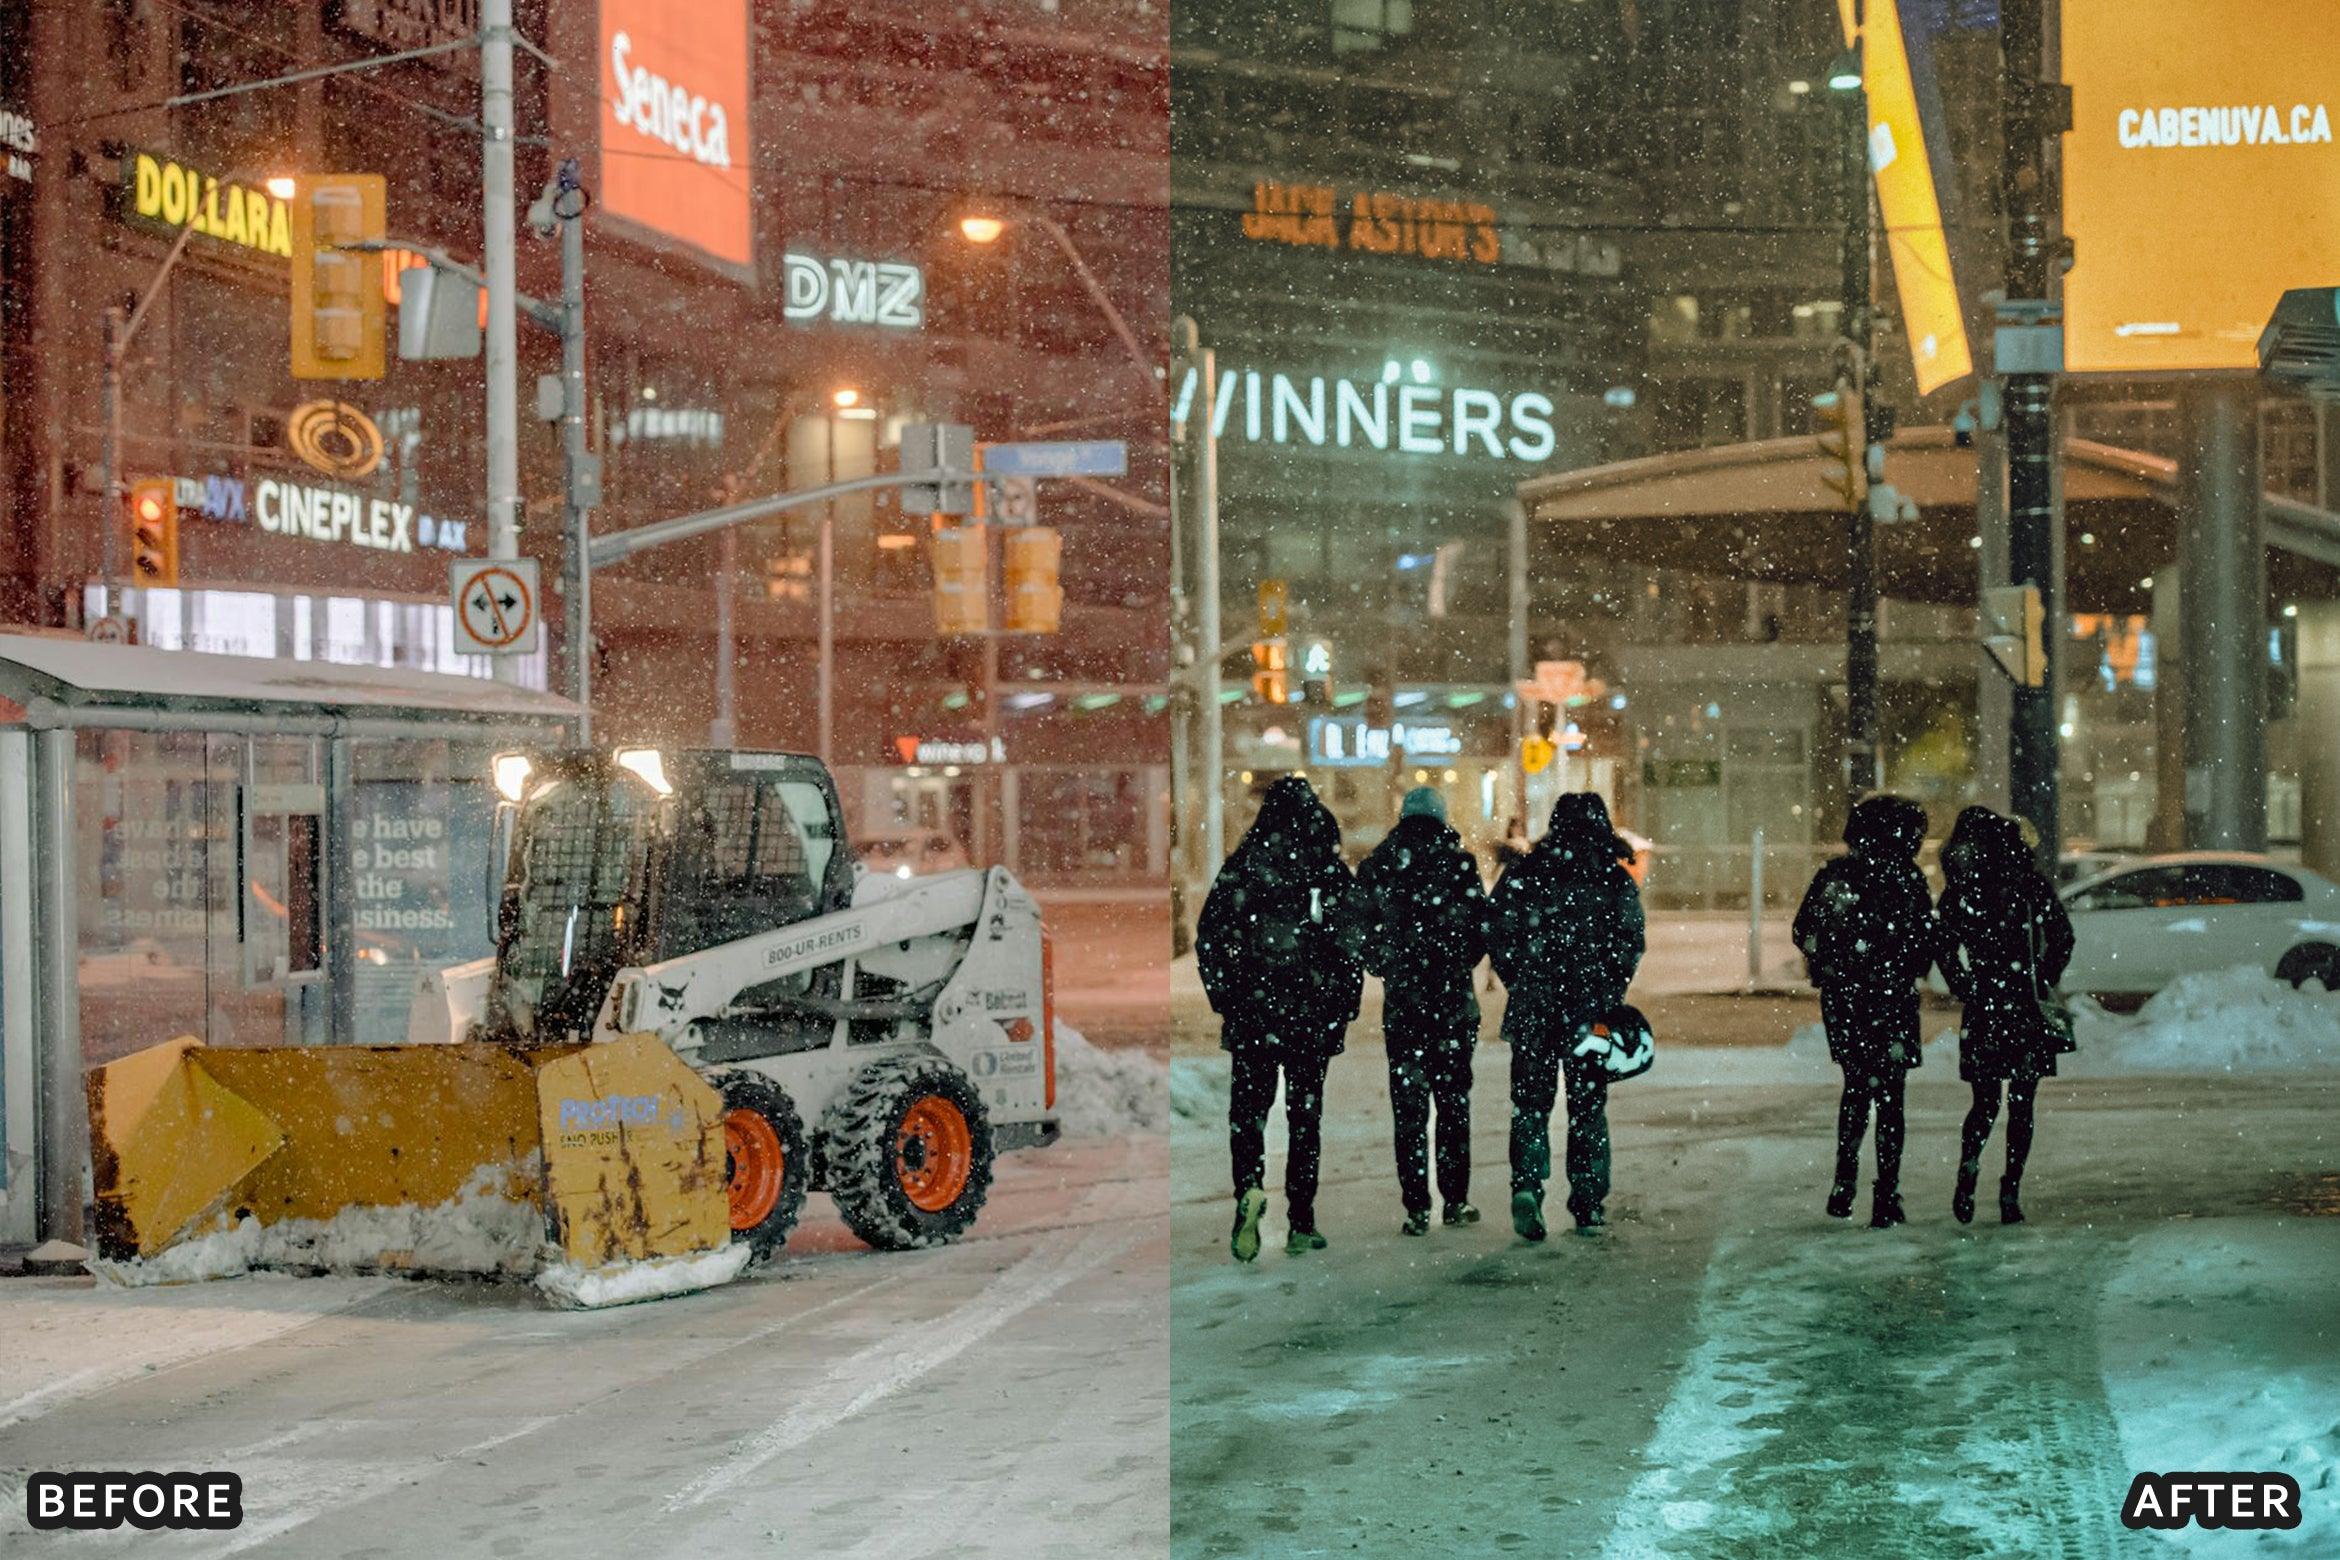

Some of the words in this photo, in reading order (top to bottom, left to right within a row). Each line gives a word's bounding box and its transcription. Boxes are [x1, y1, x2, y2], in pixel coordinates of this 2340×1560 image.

[612, 32, 731, 171] Seneca
[2118, 103, 2332, 148] CABENUVA.CA
[784, 254, 920, 326] DMZ
[256, 480, 412, 552] CINEPLEX
[373, 812, 442, 839] have
[375, 842, 436, 869] best
[357, 872, 402, 899] the
[353, 904, 453, 929] siness.
[590, 1130, 633, 1146] PUSHR
